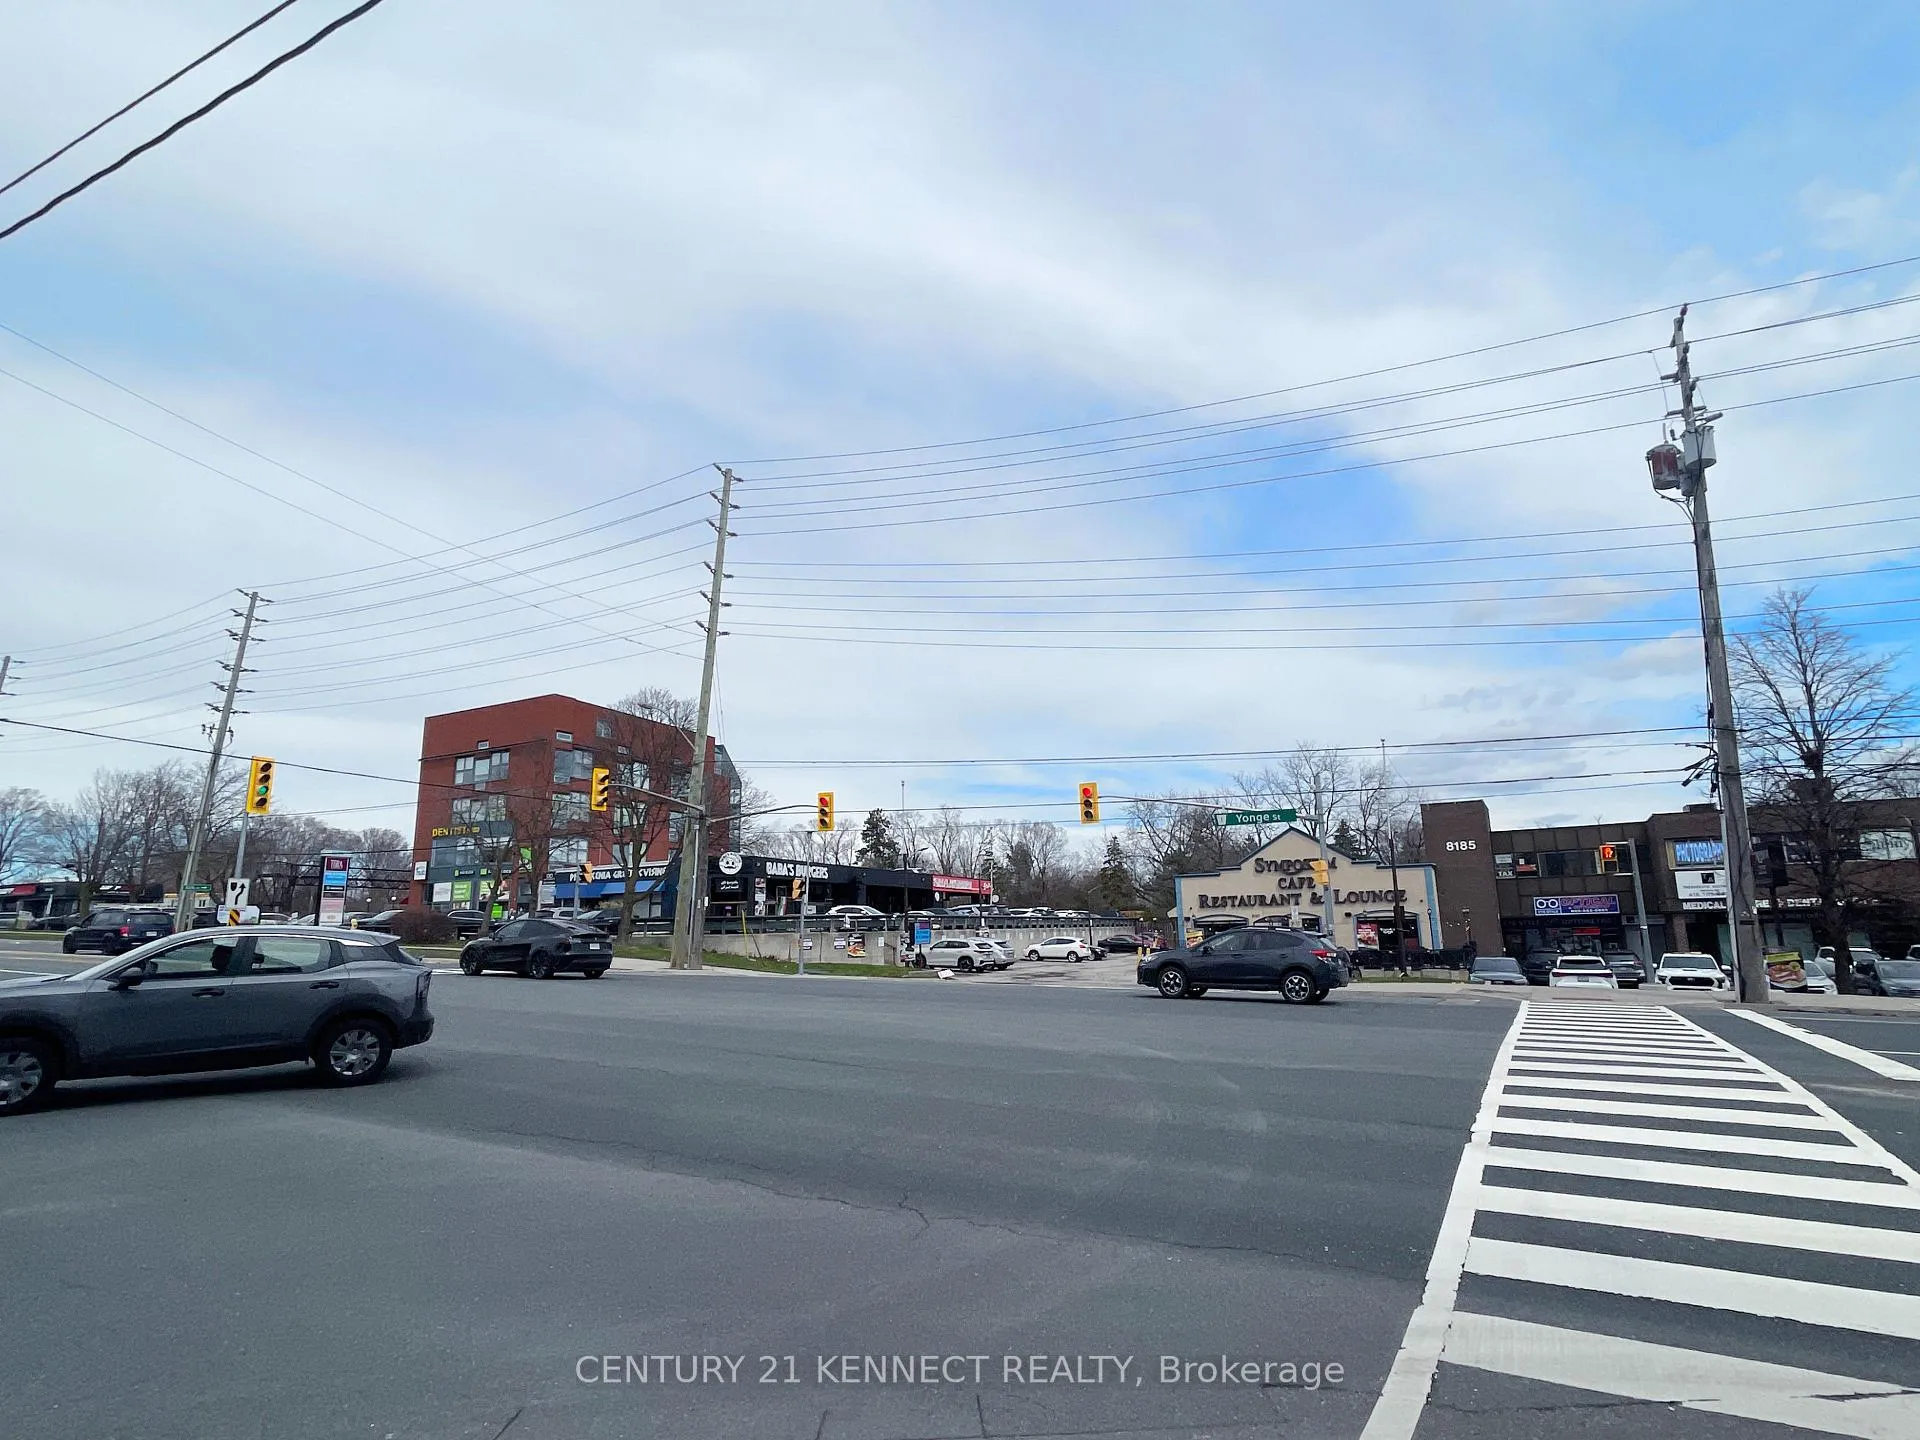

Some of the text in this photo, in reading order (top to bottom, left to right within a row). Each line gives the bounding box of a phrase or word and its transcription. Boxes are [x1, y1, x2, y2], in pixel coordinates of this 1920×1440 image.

[1236, 813, 1270, 824] Yonge
[1446, 840, 1477, 851] 8185
[766, 861, 795, 876] BABA'S
[1310, 891, 1325, 904] &
[1682, 902, 1727, 910] MEDICAL
